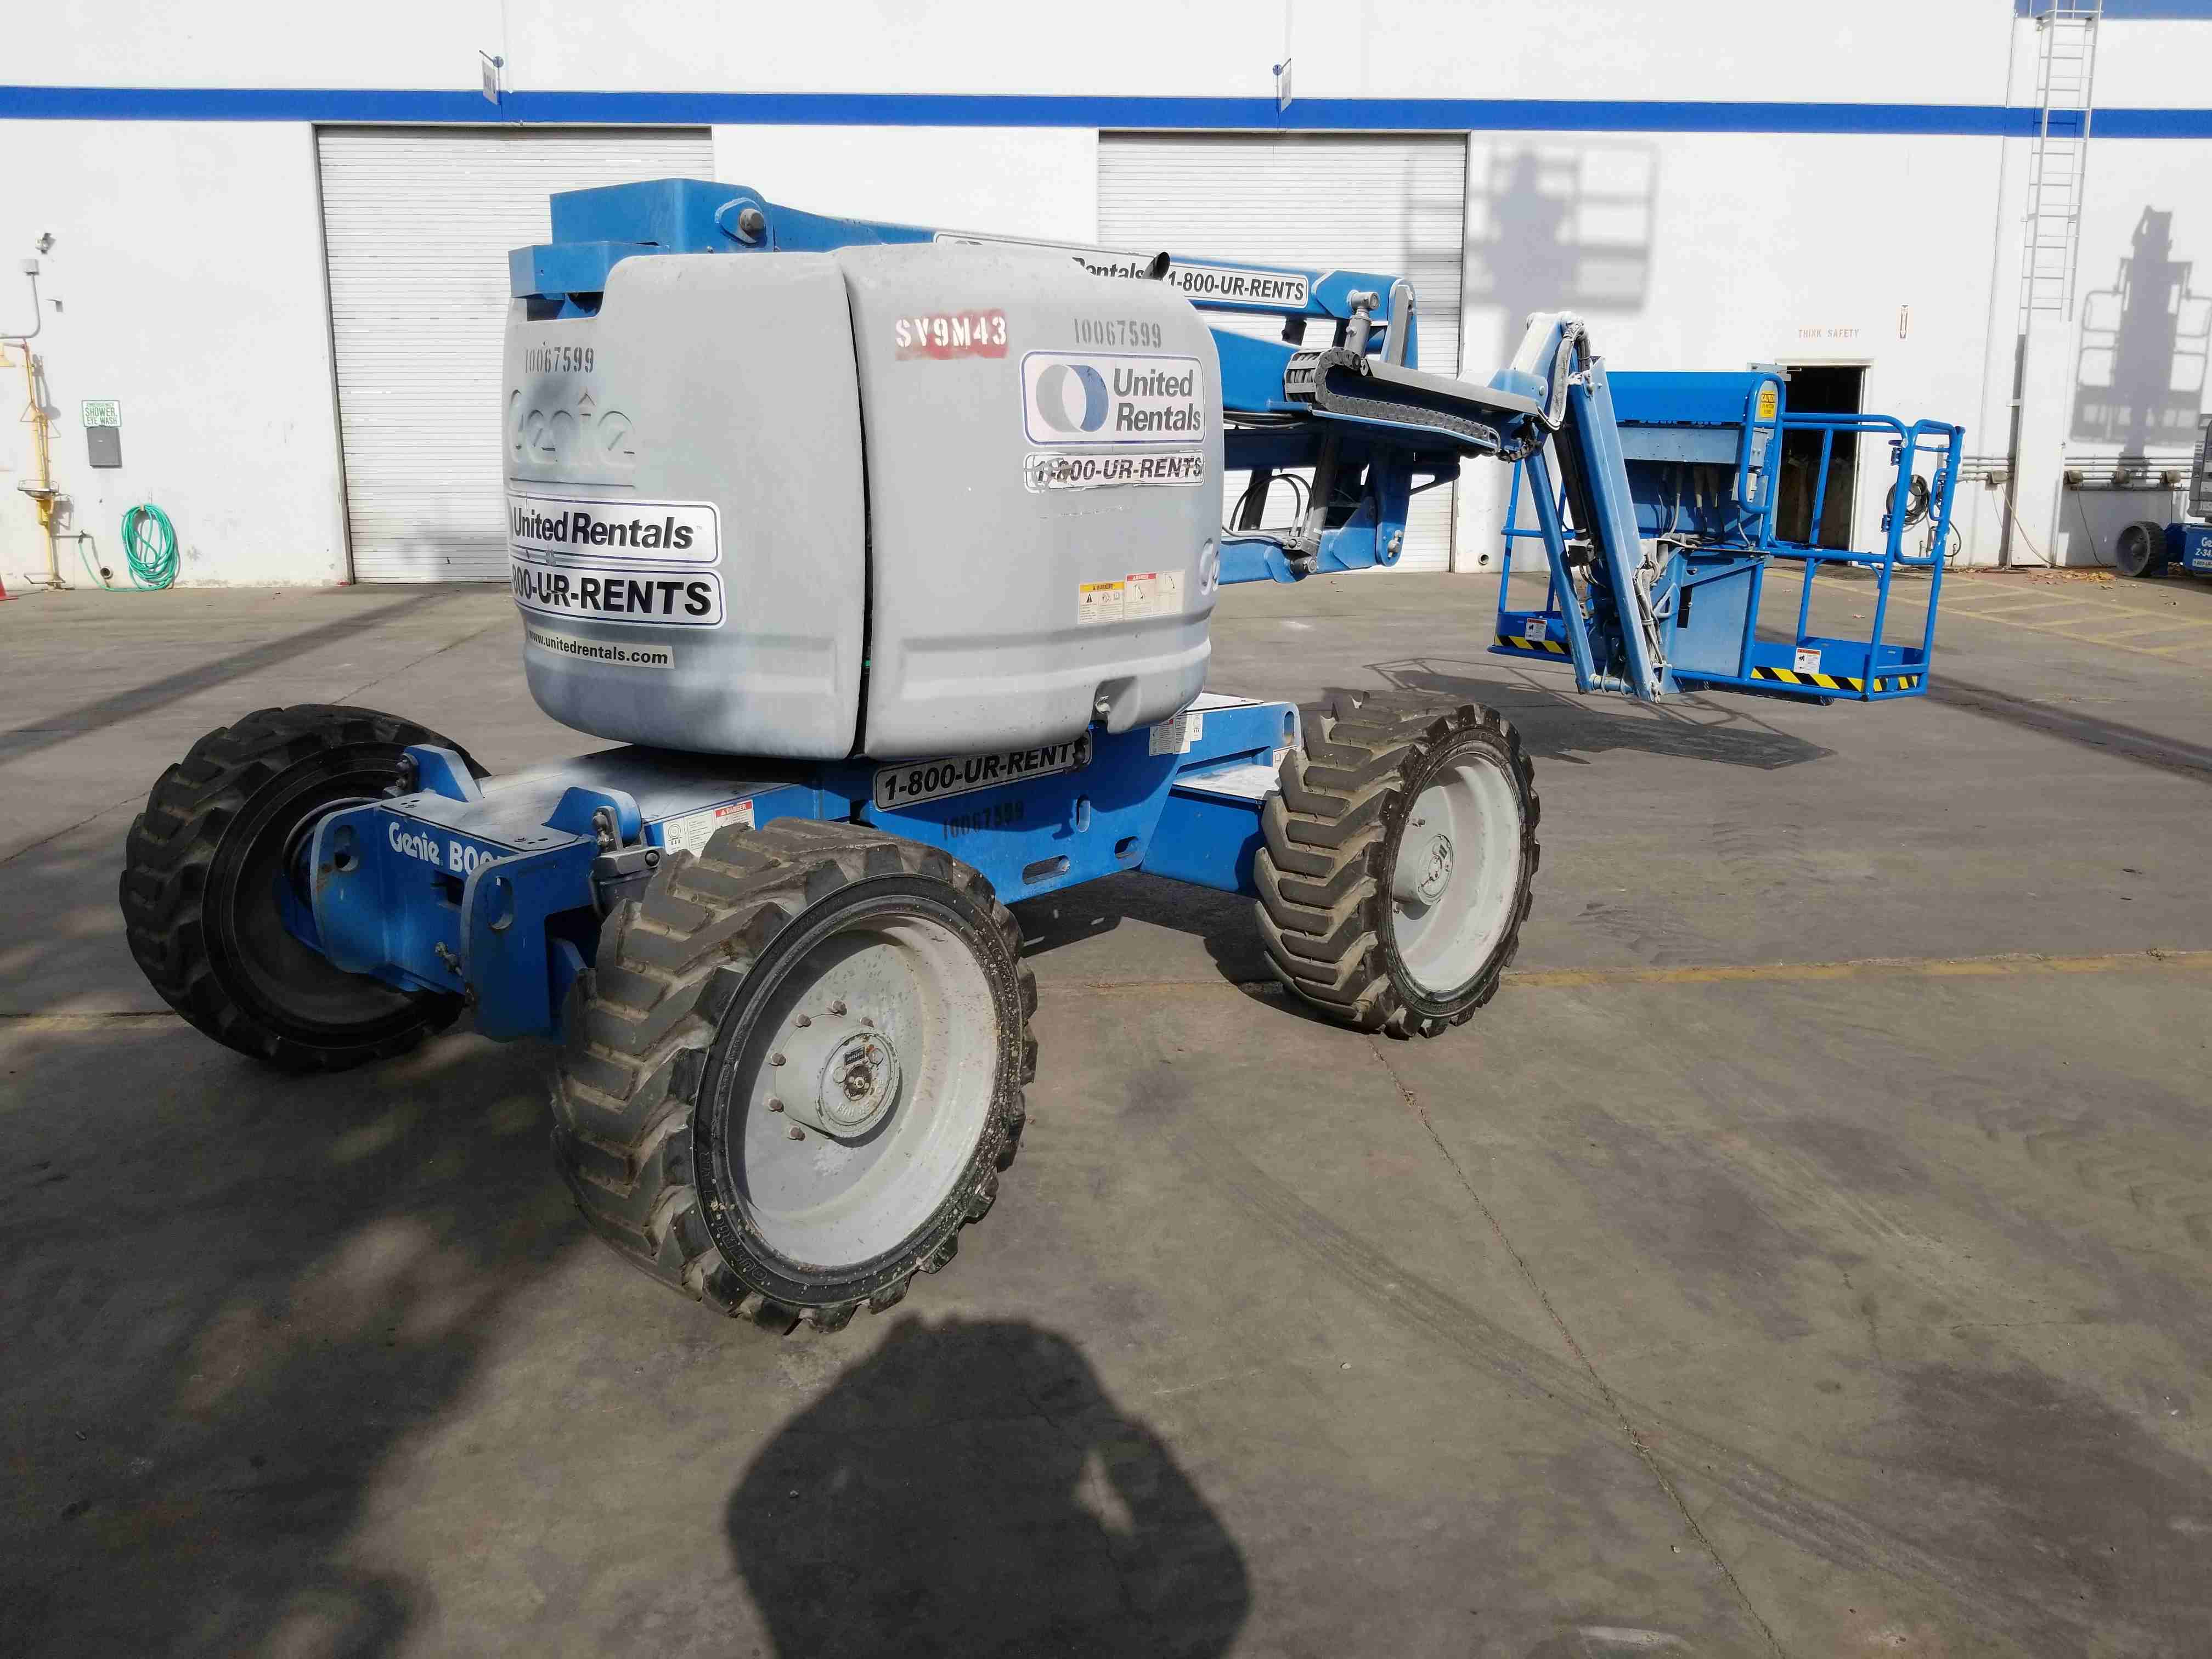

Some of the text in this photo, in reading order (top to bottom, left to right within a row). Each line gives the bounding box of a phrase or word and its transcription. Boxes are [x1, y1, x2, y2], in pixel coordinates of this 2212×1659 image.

[1168, 271, 1304, 300] 1-800-UR-RENTS
[1074, 318, 1161, 348] 10067599
[1799, 329, 1860, 338] THINK SAFETY
[525, 346, 594, 373] 10067599
[1114, 368, 1194, 397] United
[1115, 403, 1200, 431] Rentals
[514, 506, 694, 549] United Rentals
[528, 630, 668, 664] www.unitedrentals.com
[885, 741, 1082, 801] 1-800-UR-RENT
[726, 803, 747, 814] DANGER
[388, 822, 500, 876] Genie BOO
